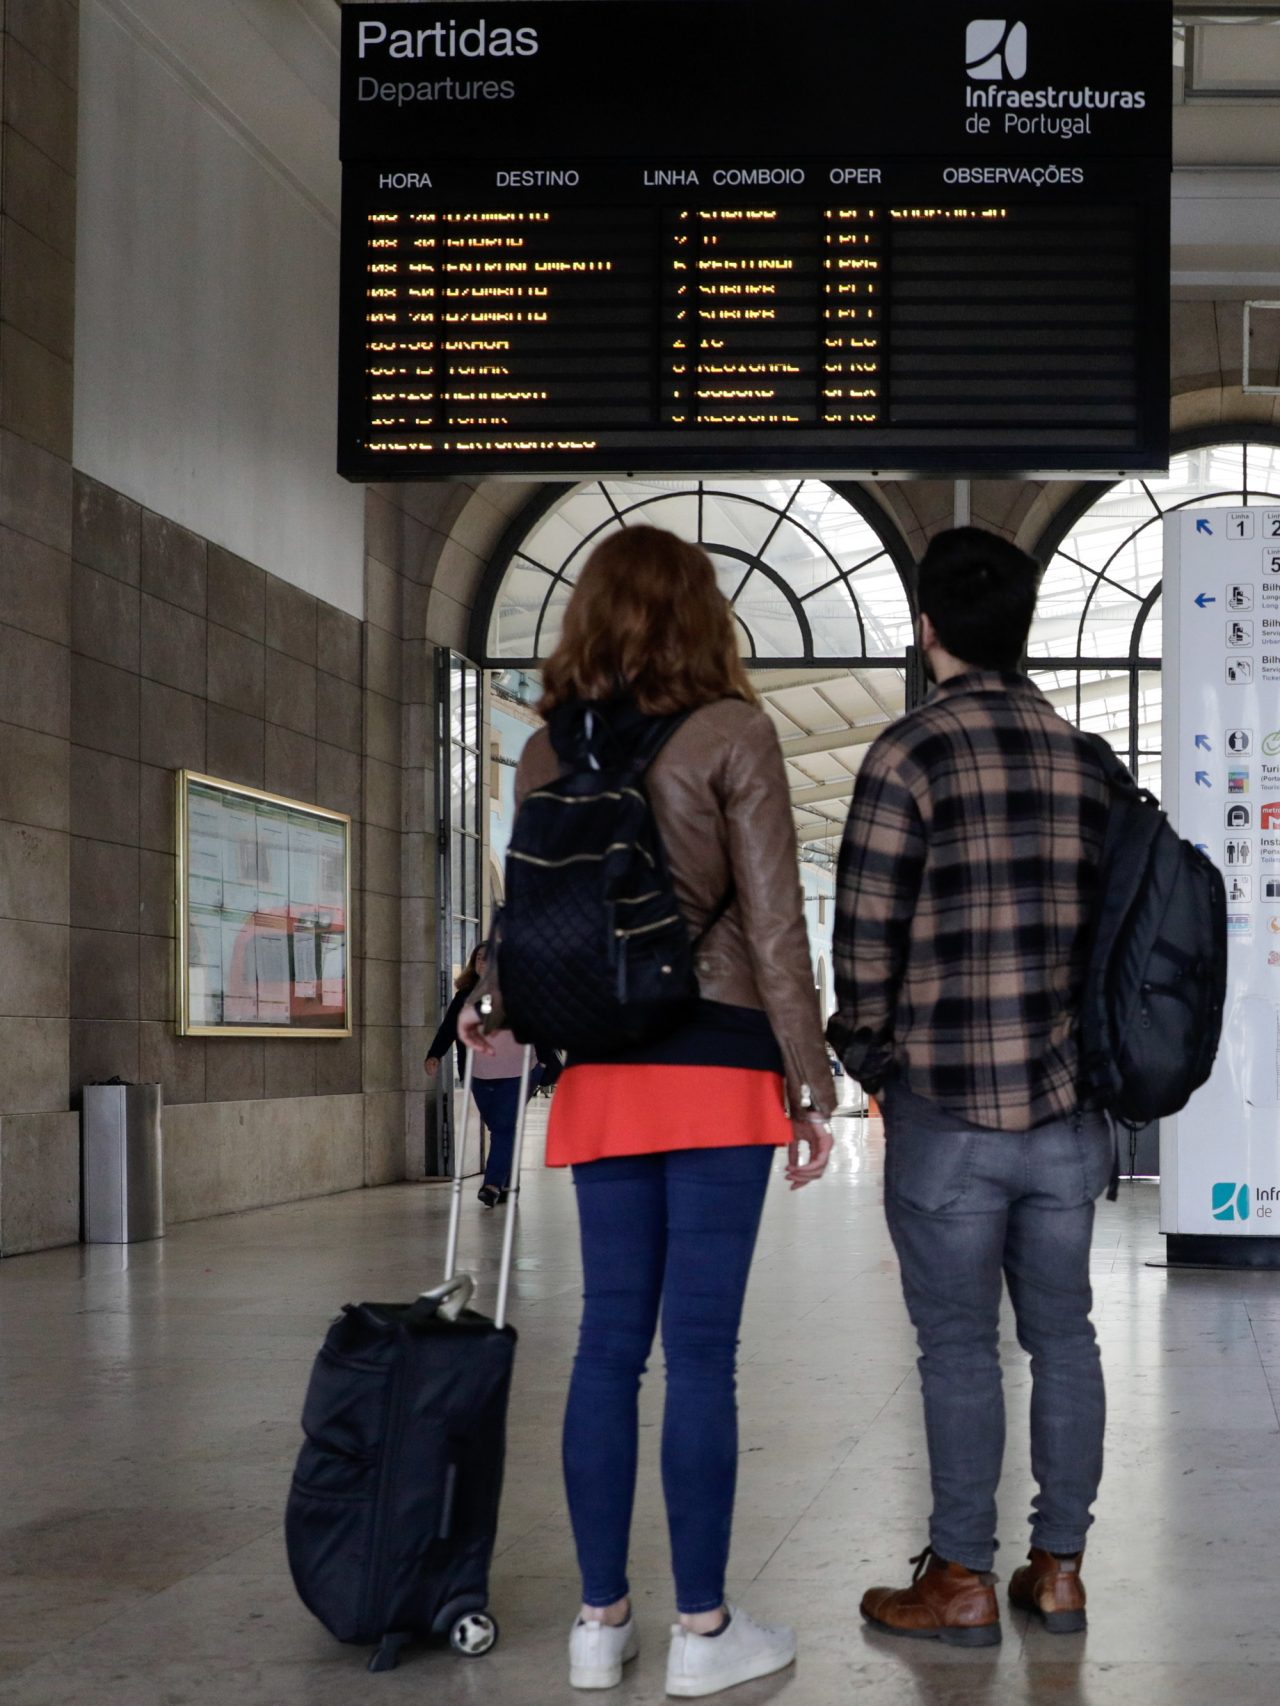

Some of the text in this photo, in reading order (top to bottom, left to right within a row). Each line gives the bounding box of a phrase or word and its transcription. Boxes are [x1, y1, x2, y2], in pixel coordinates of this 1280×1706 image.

[356, 20, 538, 59] Partidas
[356, 77, 516, 106] Departures
[965, 85, 1146, 109] Infraestruturas
[965, 112, 1092, 139] de Portugal
[378, 164, 1085, 188] HORA DESTINO LINHA COMBOIO OPER OBSERVAÇÕES
[1236, 521, 1244, 537] 1
[1256, 1204, 1273, 1218] de
